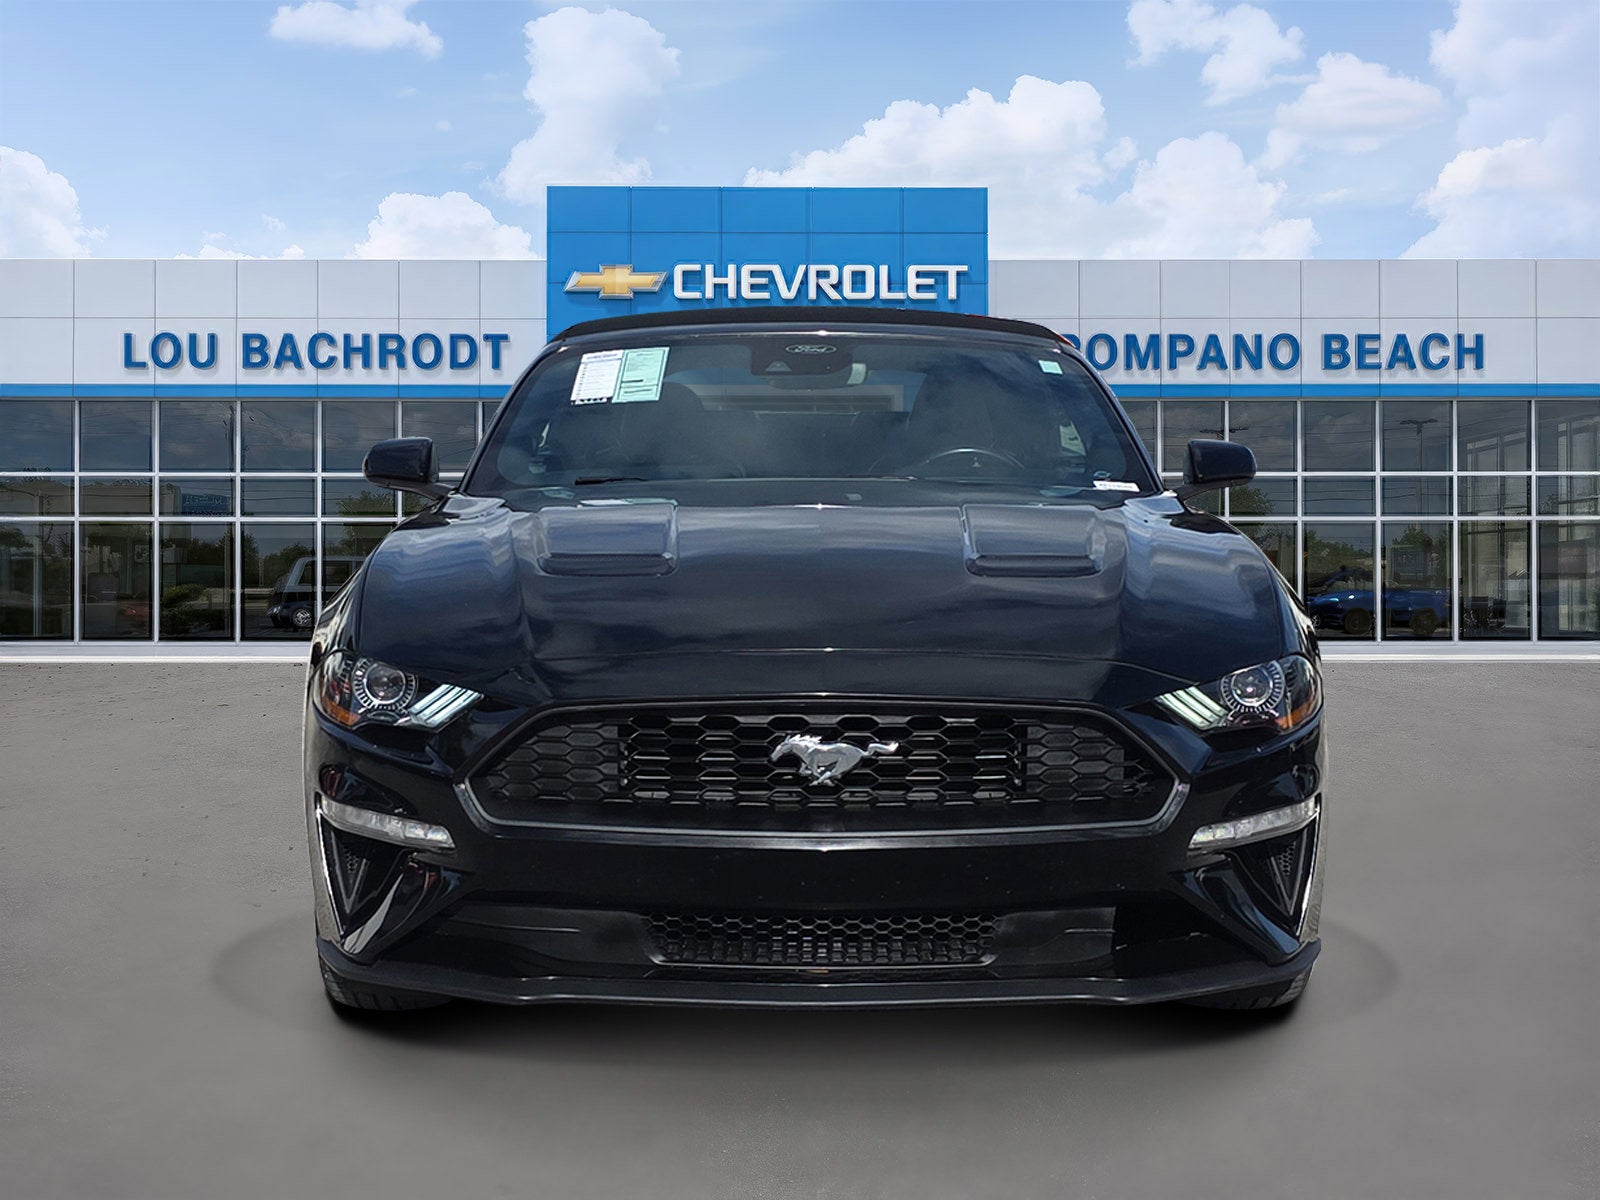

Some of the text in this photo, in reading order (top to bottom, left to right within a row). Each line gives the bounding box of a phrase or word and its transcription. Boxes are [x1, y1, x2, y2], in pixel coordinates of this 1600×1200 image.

[673, 263, 969, 302] CHEVROLET
[123, 332, 510, 370] LOU BACHRODT
[1321, 332, 1486, 371] BEACH
